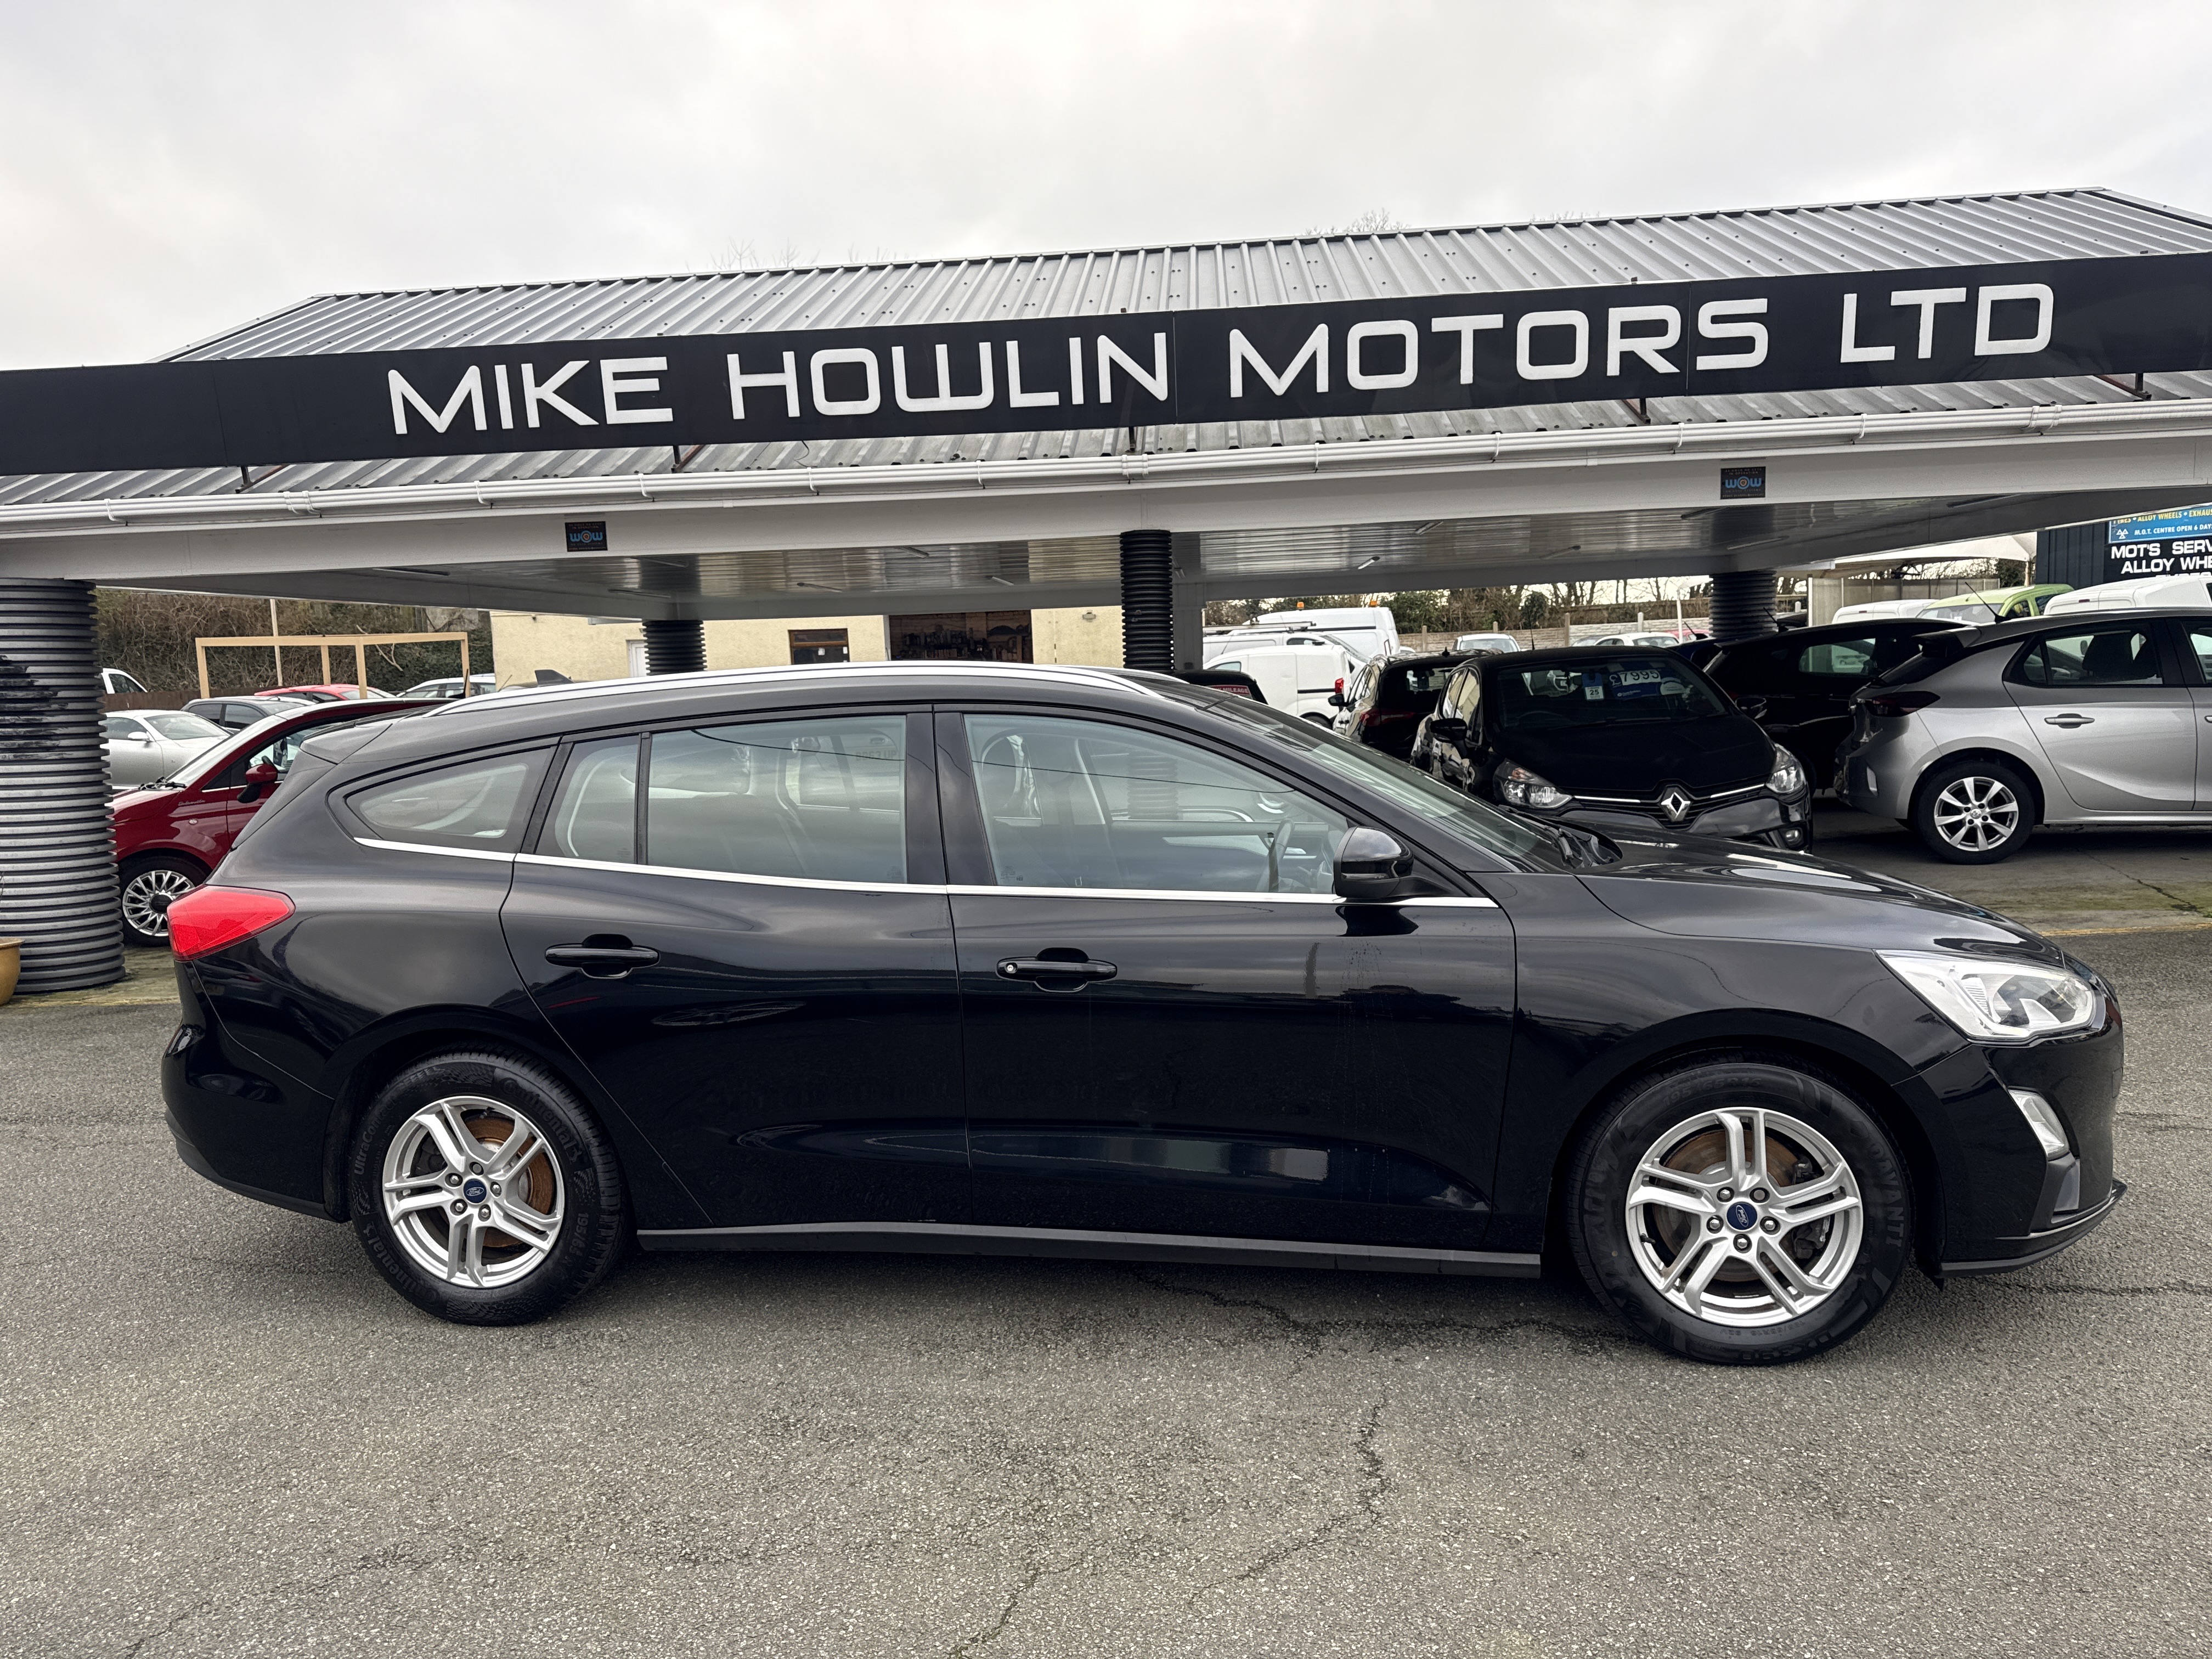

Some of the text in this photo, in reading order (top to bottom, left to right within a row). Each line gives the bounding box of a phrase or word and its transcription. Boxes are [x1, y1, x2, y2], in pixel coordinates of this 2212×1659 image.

[388, 283, 2054, 435] MIKE HOWLIN MOTORS LTD
[2158, 511, 2182, 520] WHEELS
[2111, 543, 2161, 559] MOT'S
[2120, 557, 2175, 574] ALLOY
[1867, 1143, 1904, 1247] DAVANTI
